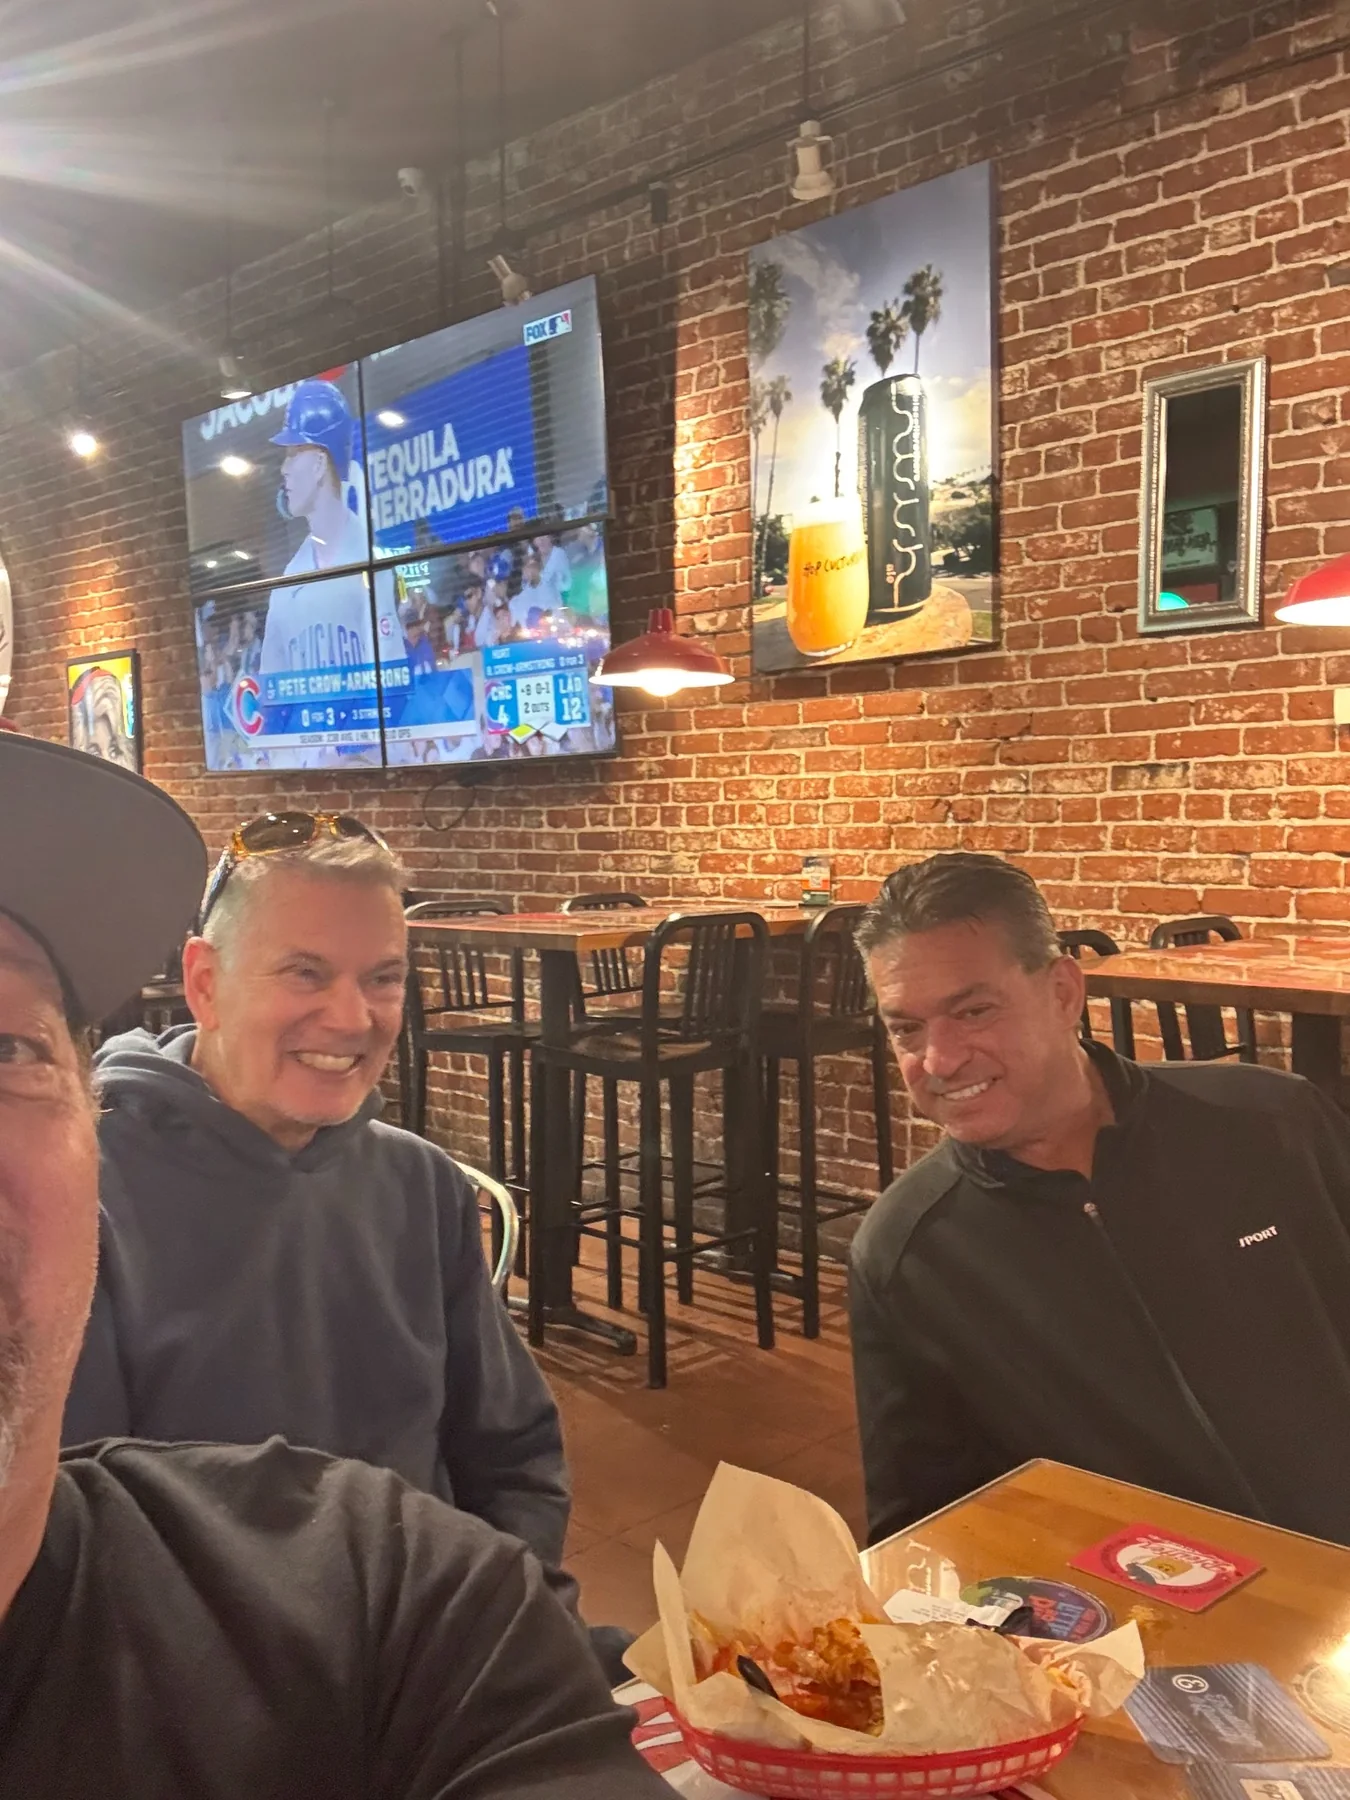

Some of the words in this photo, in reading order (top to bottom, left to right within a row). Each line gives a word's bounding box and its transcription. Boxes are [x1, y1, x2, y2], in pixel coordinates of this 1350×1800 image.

[526, 321, 547, 342] FOX
[367, 423, 460, 491] TEQUILA
[278, 676, 307, 697] PETE
[308, 666, 410, 694] CROW-ARMSRONG
[559, 677, 583, 694] LAD
[301, 708, 310, 727] 0
[326, 707, 335, 725] 3
[523, 702, 530, 714] 2
[531, 702, 550, 713] OUTS
[562, 696, 583, 721] 12
